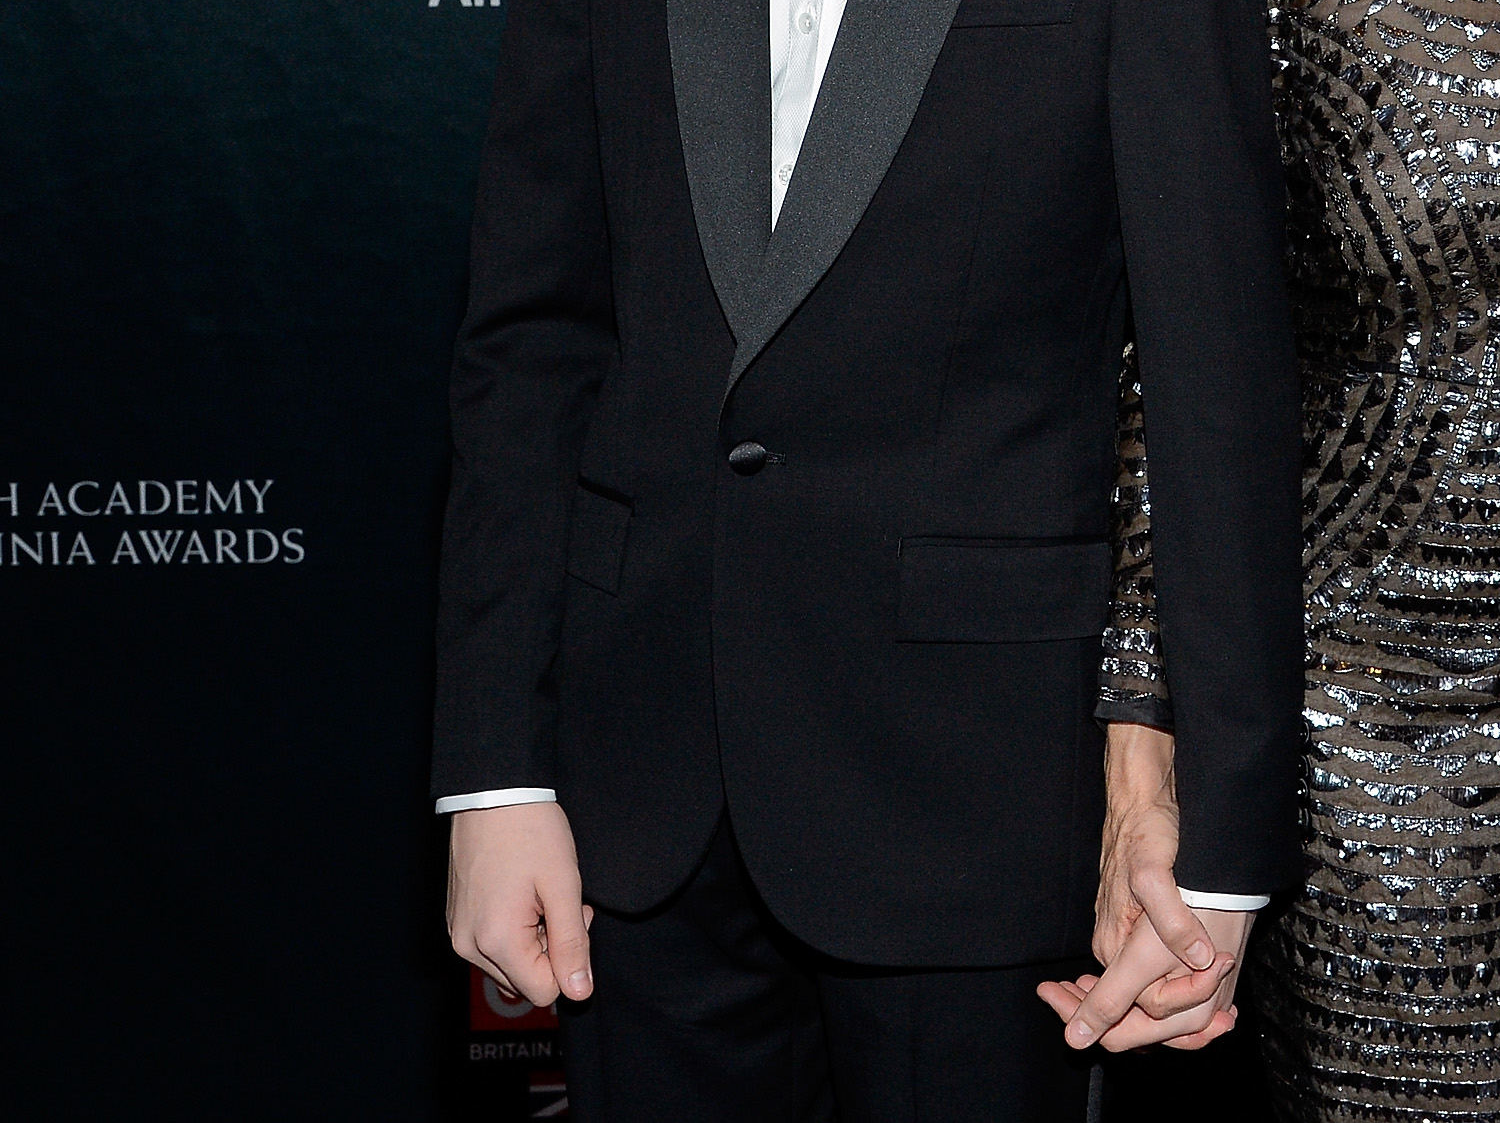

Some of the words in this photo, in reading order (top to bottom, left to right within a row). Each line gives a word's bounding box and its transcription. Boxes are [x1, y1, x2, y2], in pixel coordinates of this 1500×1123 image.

[37, 479, 274, 517] ACADEMY
[111, 528, 305, 565] AWARDS
[469, 1040, 553, 1061] BRITAIN
